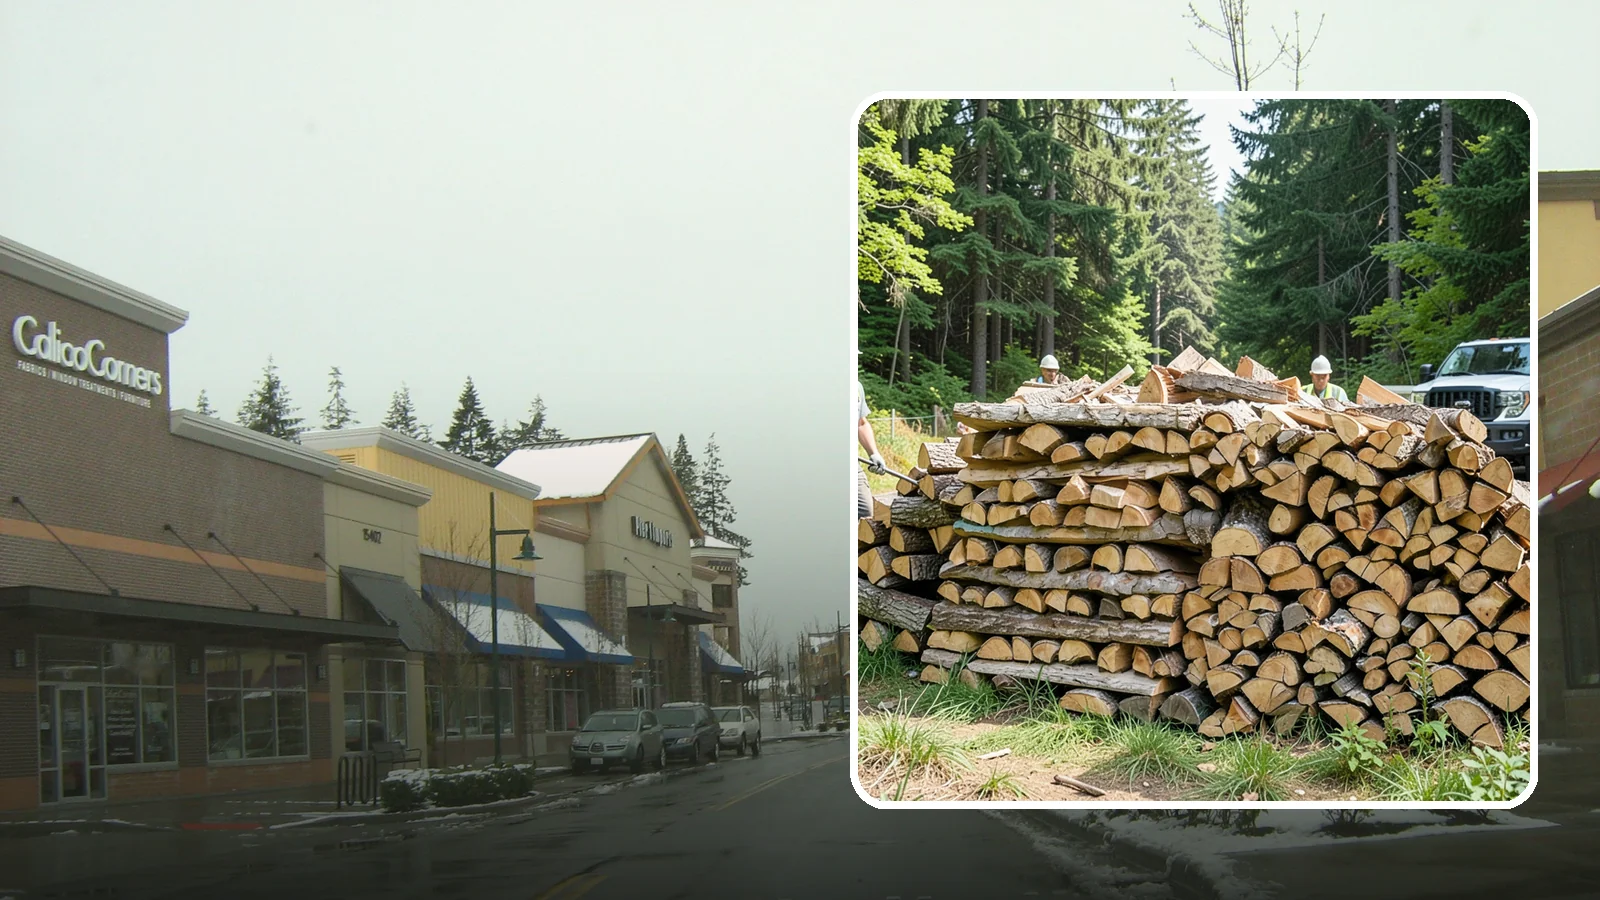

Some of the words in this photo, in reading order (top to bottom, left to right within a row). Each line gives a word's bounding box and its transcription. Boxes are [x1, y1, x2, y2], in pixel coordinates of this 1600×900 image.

[17, 360, 46, 377] FABRICS
[51, 371, 78, 386] WINDOW
[79, 378, 116, 397] TREATMENTS
